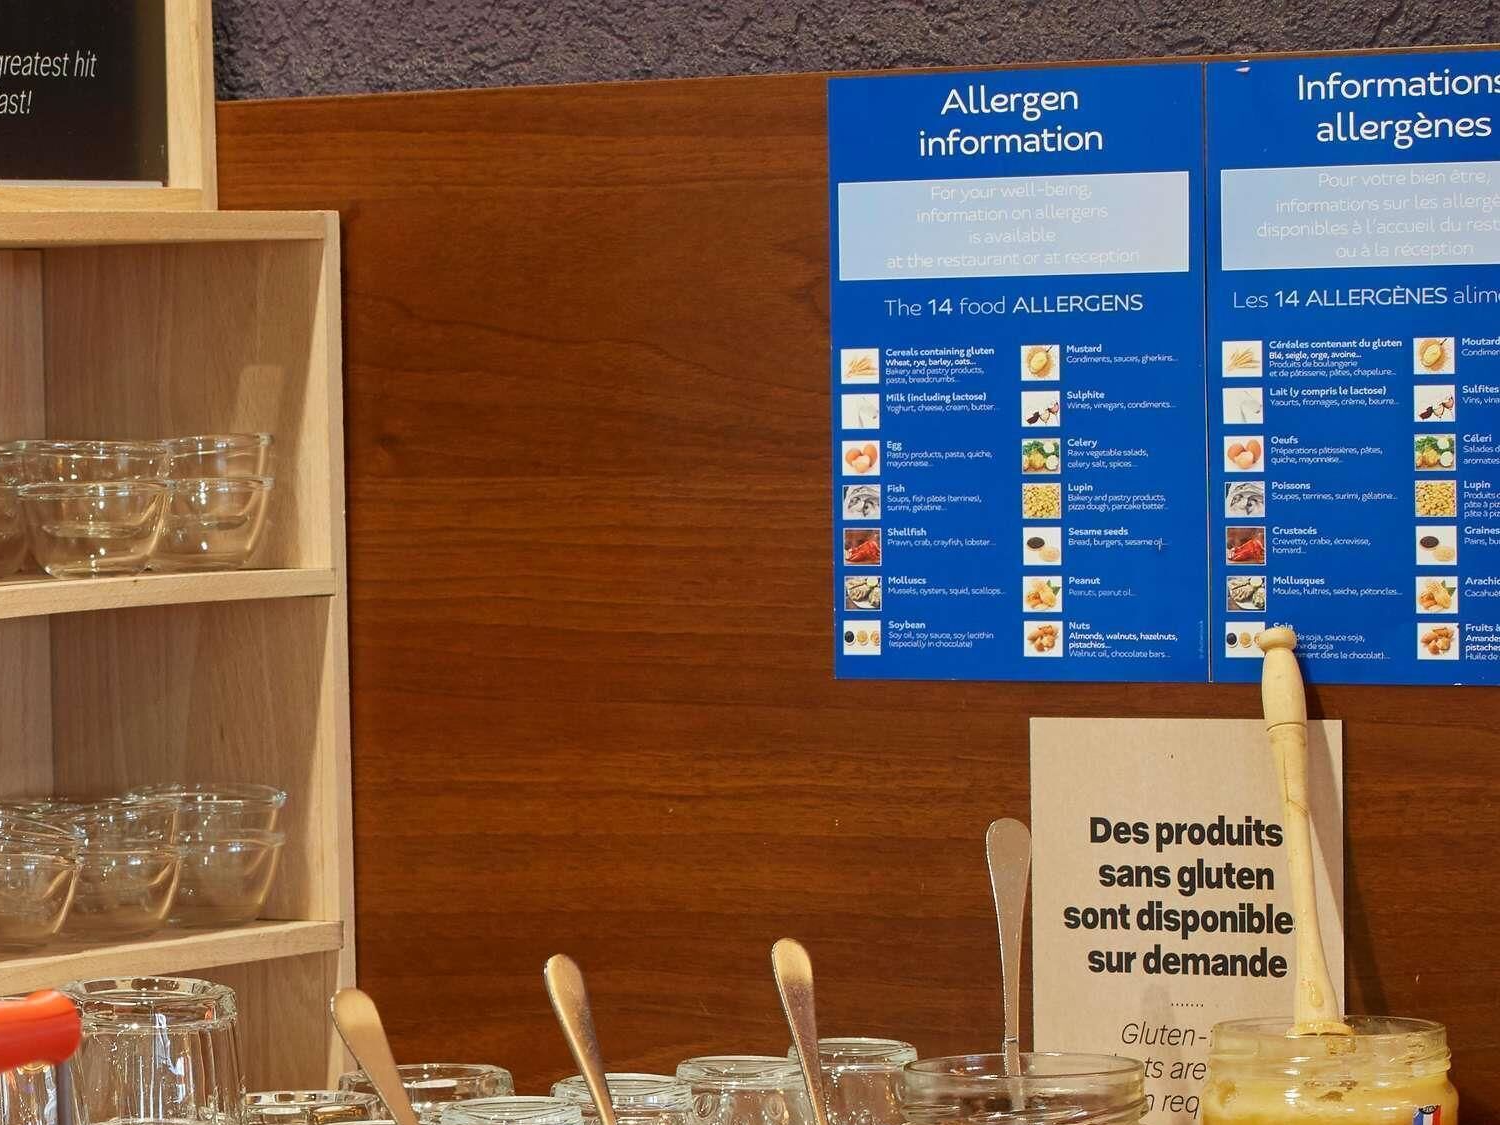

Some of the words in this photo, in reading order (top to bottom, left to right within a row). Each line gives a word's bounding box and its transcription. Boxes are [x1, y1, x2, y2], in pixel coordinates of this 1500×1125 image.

[74, 50, 98, 78] hit
[1298, 68, 1500, 101] Informations
[941, 85, 1079, 121] Allergen
[1316, 111, 1492, 150] allergènes
[919, 126, 1103, 157] information
[1318, 173, 1357, 188] Pour
[1362, 172, 1406, 186] votre
[1411, 169, 1446, 184] bien
[1450, 168, 1492, 185] être,
[931, 186, 956, 201] For
[959, 185, 997, 203] your
[1000, 181, 1093, 200] well-being,
[1276, 198, 1380, 214] informations
[1383, 197, 1408, 211] sur
[1414, 194, 1438, 209] les
[916, 206, 1009, 224] information
[1011, 208, 1033, 222] on
[1035, 203, 1109, 223] allergens
[1256, 221, 1349, 240] disponibles
[1352, 221, 1362, 235] à
[1366, 218, 1435, 235] l'accueil
[1440, 216, 1461, 232] du
[969, 229, 982, 244] is
[984, 226, 1056, 244] available
[1335, 245, 1357, 259] ou
[1360, 243, 1370, 257] à
[1374, 242, 1389, 257] la
[1394, 239, 1476, 260] réception
[886, 253, 904, 268] at
[907, 251, 934, 269] the
[937, 250, 1019, 267] restaurant
[1023, 251, 1041, 265] or
[1044, 249, 1061, 264] at
[1065, 247, 1140, 267] reception
[1233, 291, 1269, 309] Les
[1274, 289, 1299, 308] 14
[1305, 284, 1447, 307] ALLERGÈNES
[884, 299, 922, 316] The
[928, 298, 953, 316] 14
[959, 296, 1006, 315] food
[1012, 294, 1144, 313] ALLERGENS
[1066, 345, 1102, 353] Mustard
[1269, 340, 1309, 349] Céréales
[1310, 339, 1357, 348] contenant
[1358, 338, 1371, 347] du
[1372, 338, 1402, 350] gluten
[886, 348, 918, 356] Cereals
[920, 347, 965, 357] containing
[966, 346, 994, 357] gluten
[908, 393, 951, 403] (including
[952, 392, 987, 401] lactose)
[1067, 391, 1105, 401] Sulphite
[1270, 387, 1288, 396] Lait
[1301, 386, 1338, 398] compris
[1339, 386, 1348, 396] le
[1350, 386, 1387, 396] lactose)
[1067, 439, 1097, 448] Celery
[1271, 436, 1299, 445] Oeufs
[1463, 434, 1492, 443] Céleri
[887, 441, 902, 451] Egg
[887, 484, 905, 493] Fish
[1068, 484, 1093, 493] Lupin
[1271, 481, 1311, 490] Poissons
[1463, 480, 1491, 490] Lupin
[887, 528, 927, 537] Shellfish
[1068, 527, 1102, 536] Sesame
[1104, 527, 1129, 536] seeds
[1272, 526, 1317, 535] Crustacés
[888, 576, 927, 585] Molluscs
[1068, 576, 1101, 585] Peanut
[1273, 577, 1325, 587] Mollusques
[888, 621, 926, 630] Soybean
[1069, 622, 1091, 630] Nuts
[1465, 623, 1493, 632] Fruits
[1090, 816, 1150, 845] Des
[1156, 815, 1284, 853] produits
[1099, 864, 1171, 888] sans
[1177, 858, 1274, 897] gluten
[1064, 903, 1130, 930] sont
[1136, 901, 1296, 940] disponible
[1088, 949, 1136, 973] sur
[1143, 944, 1288, 978] demande
[1121, 1020, 1212, 1047] Gluten-
[1170, 1061, 1207, 1080] are
[1161, 1093, 1200, 1120] req
